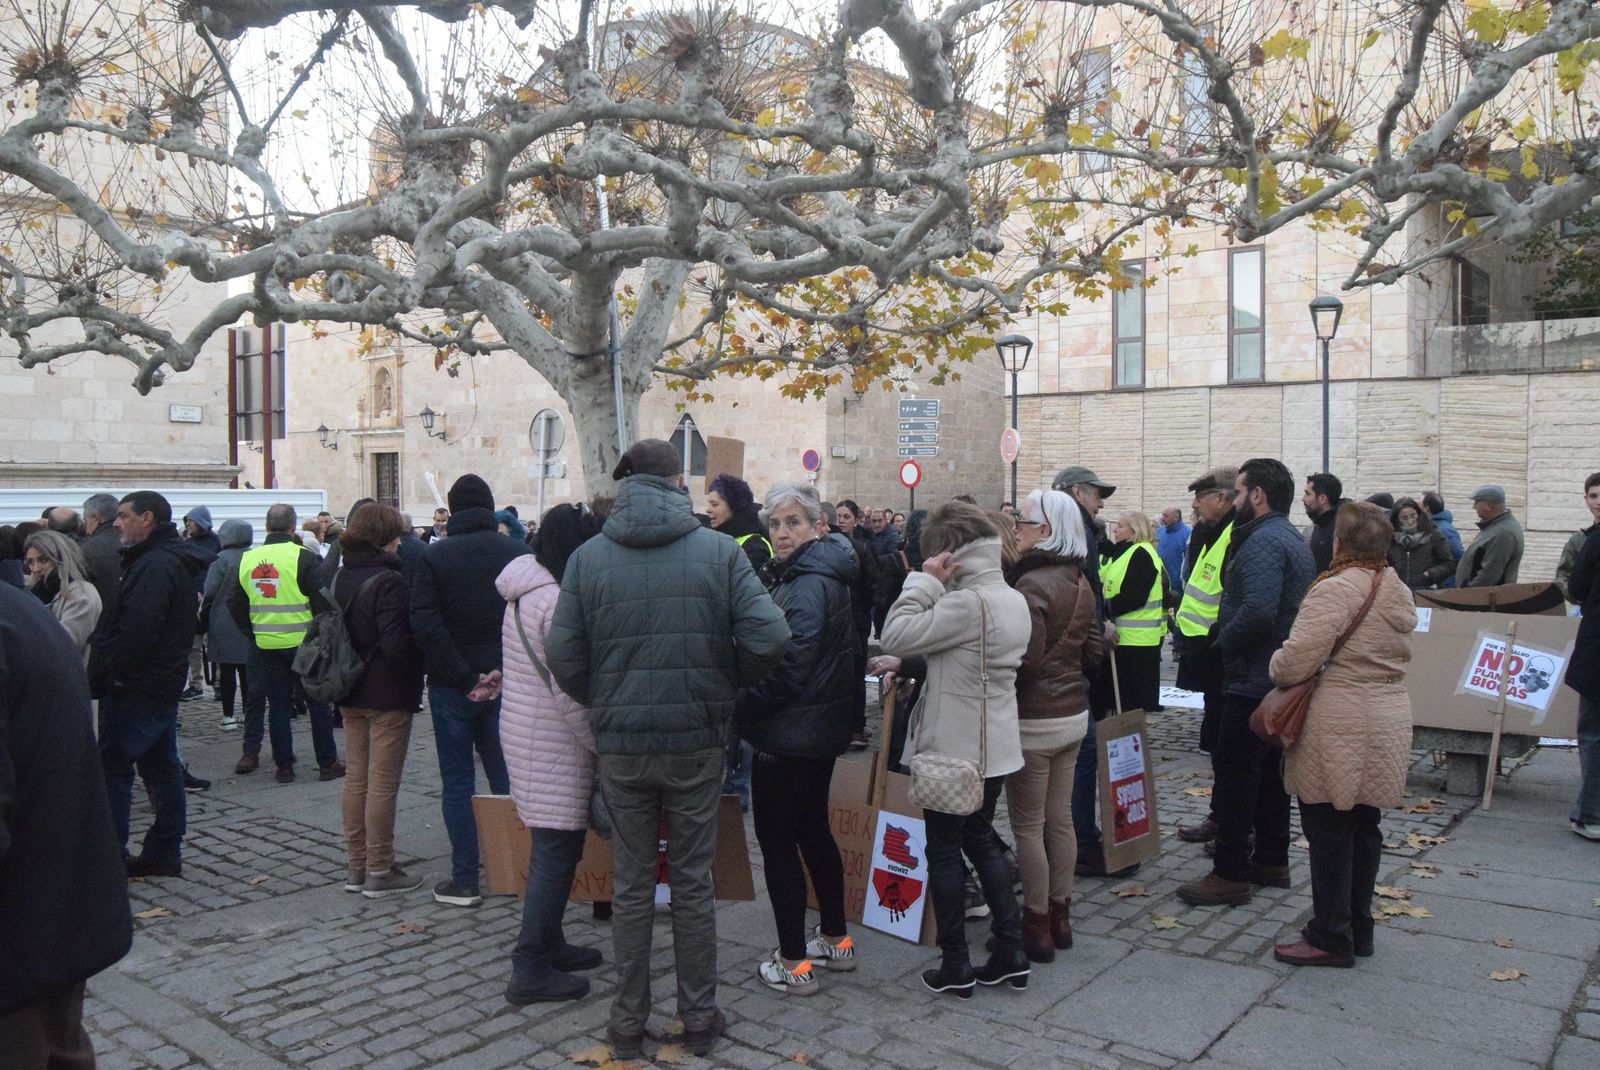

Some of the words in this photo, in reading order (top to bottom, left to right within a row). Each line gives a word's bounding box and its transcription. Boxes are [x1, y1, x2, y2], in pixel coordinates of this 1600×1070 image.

[1477, 648, 1524, 676] NO
[1474, 668, 1515, 685] PLANA
[1127, 800, 1147, 824] STOP
[887, 864, 909, 875] ZAMORA
